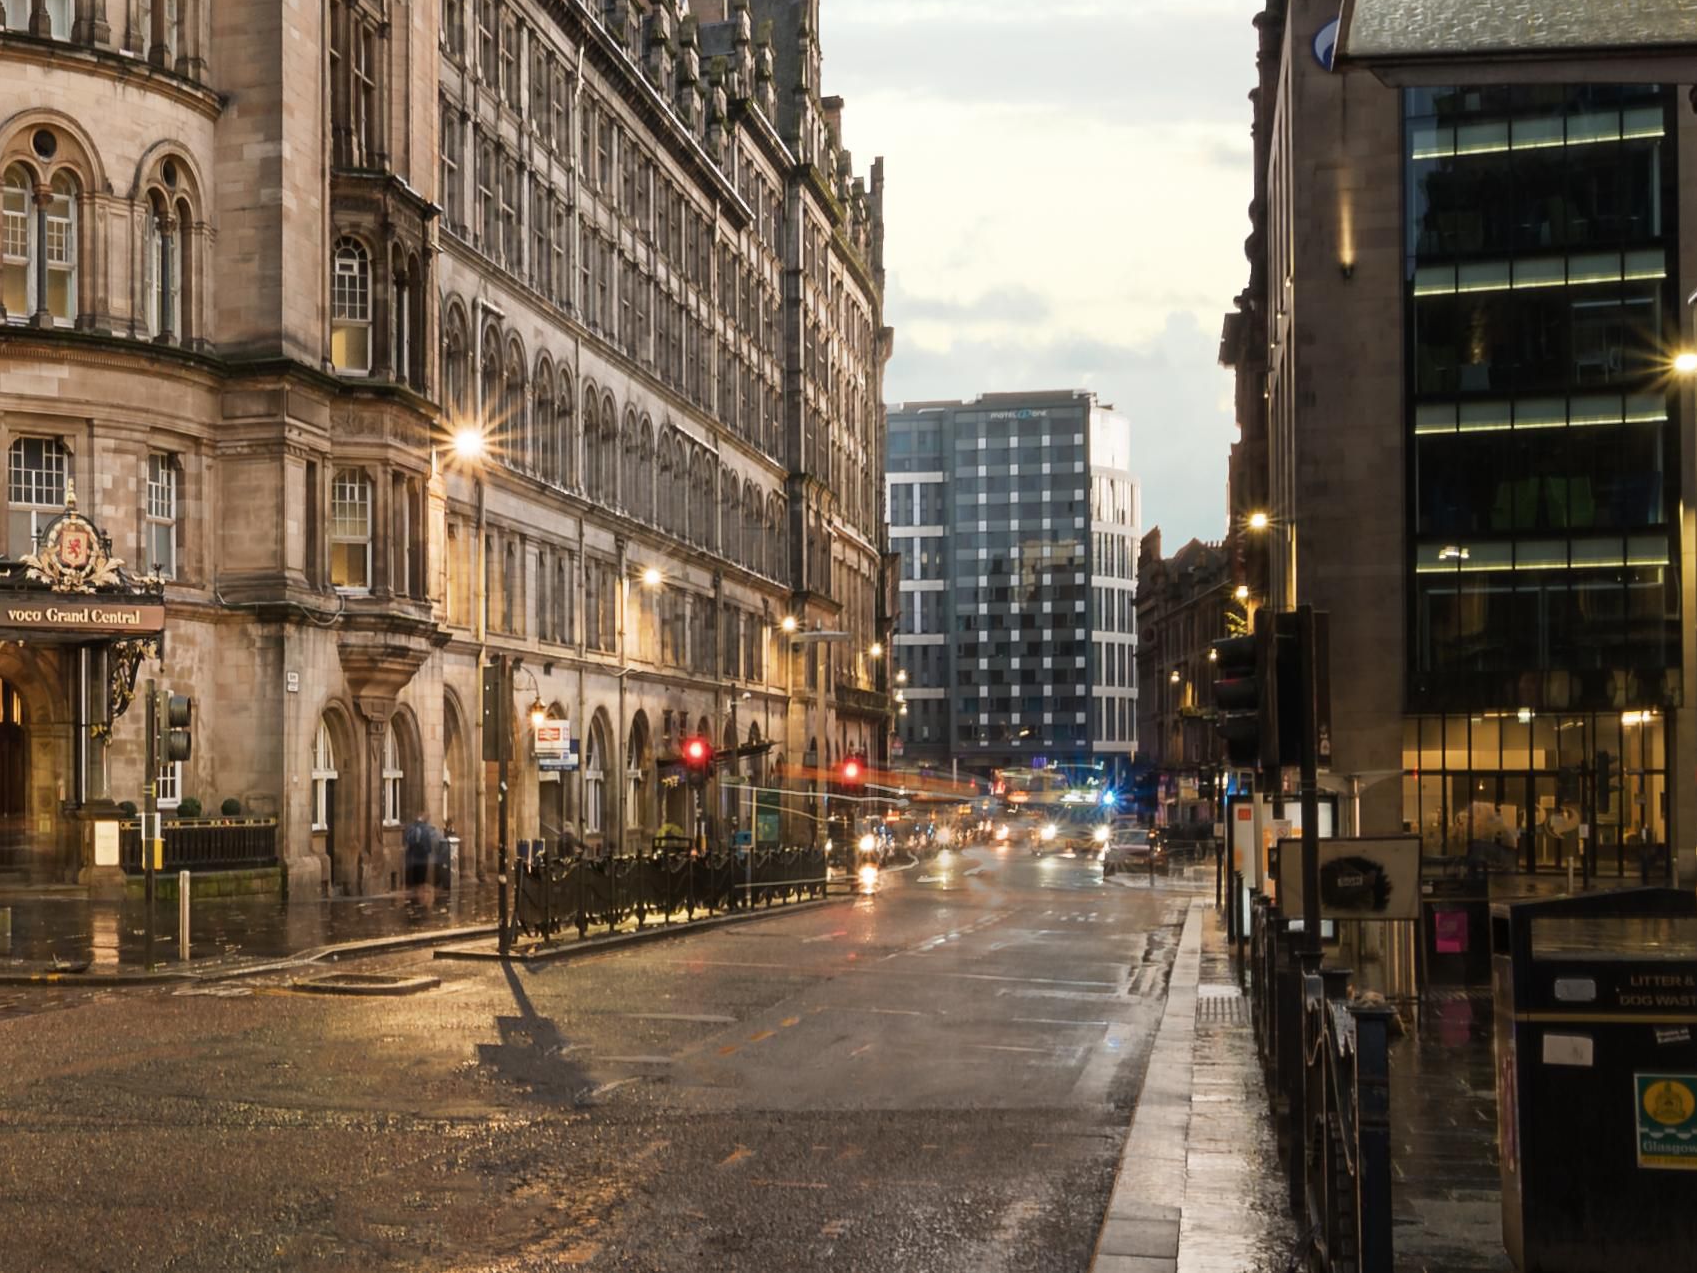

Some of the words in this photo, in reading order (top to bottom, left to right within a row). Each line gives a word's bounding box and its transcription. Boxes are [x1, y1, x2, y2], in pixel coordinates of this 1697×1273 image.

[8, 610, 42, 621] voco
[46, 608, 89, 623] Grand
[91, 610, 140, 624] Central
[1631, 975, 1679, 987] LITTER
[1684, 975, 1695, 987] &
[1620, 995, 1653, 1007] DOG
